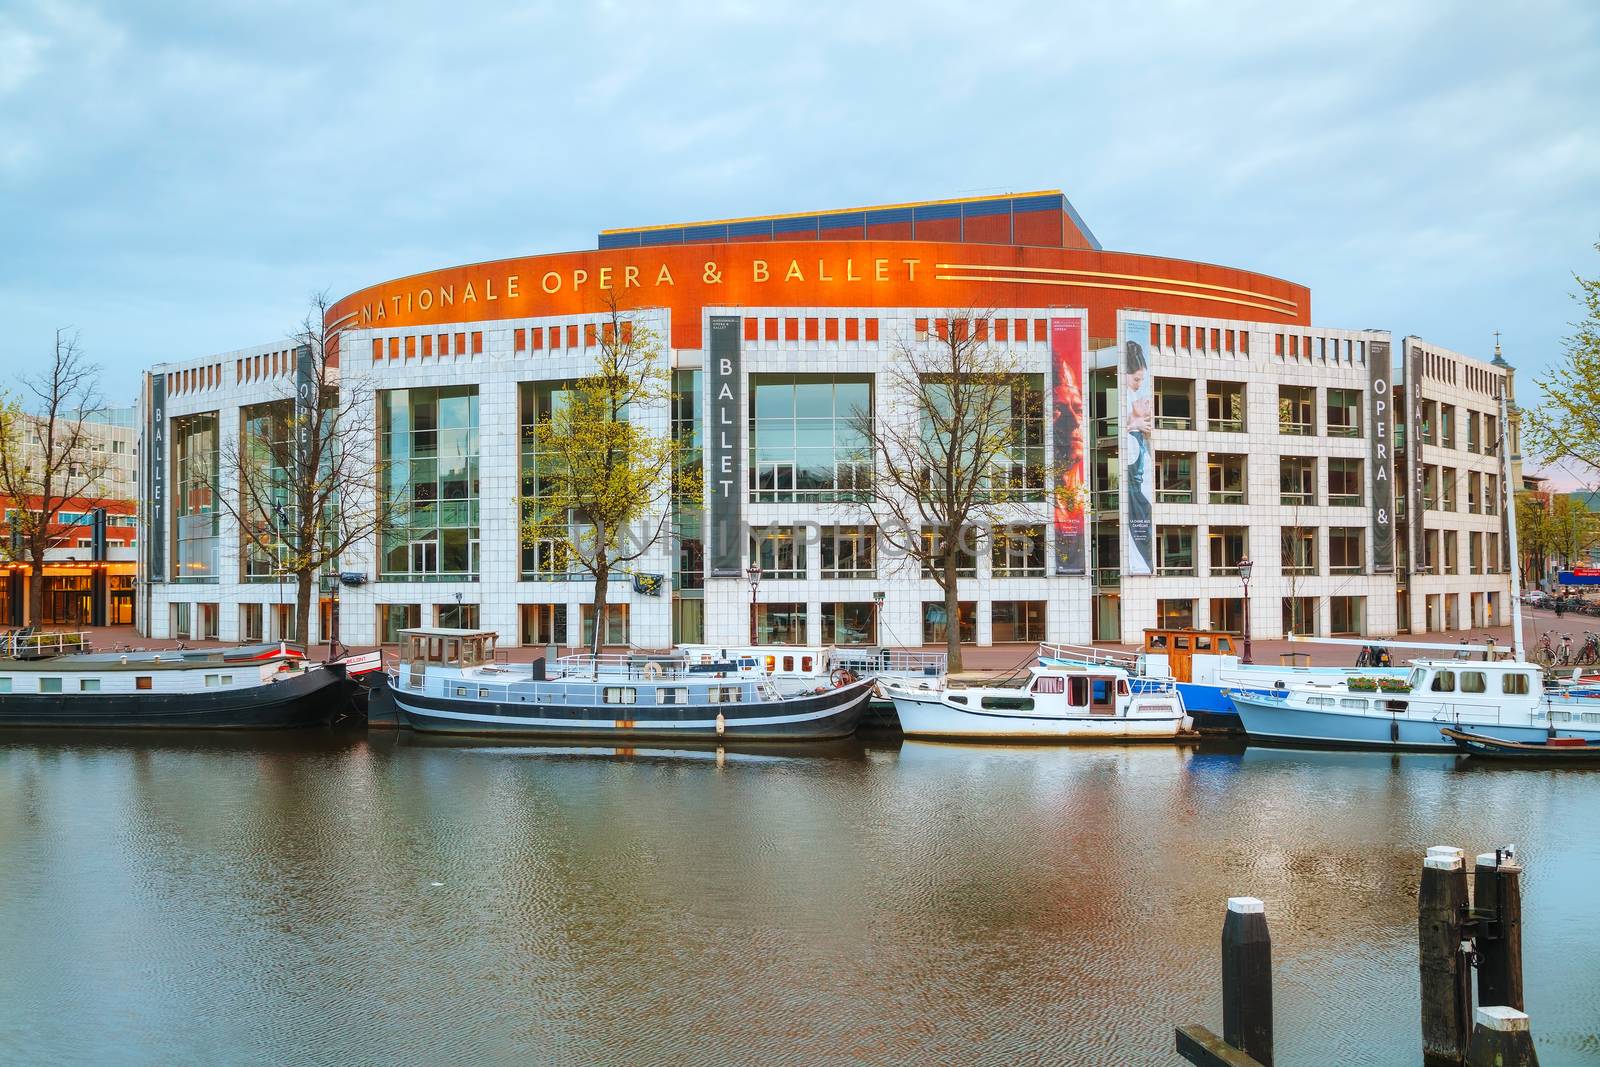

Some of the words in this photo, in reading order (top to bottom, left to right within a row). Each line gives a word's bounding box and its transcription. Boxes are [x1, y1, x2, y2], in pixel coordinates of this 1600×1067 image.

[363, 275, 520, 323] NATIONALE
[541, 263, 675, 294] OPERA
[702, 261, 722, 285] &
[752, 258, 921, 284] BALLET
[718, 357, 734, 498] BALLET
[1374, 379, 1387, 481] OPERA
[1377, 508, 1388, 524] &
